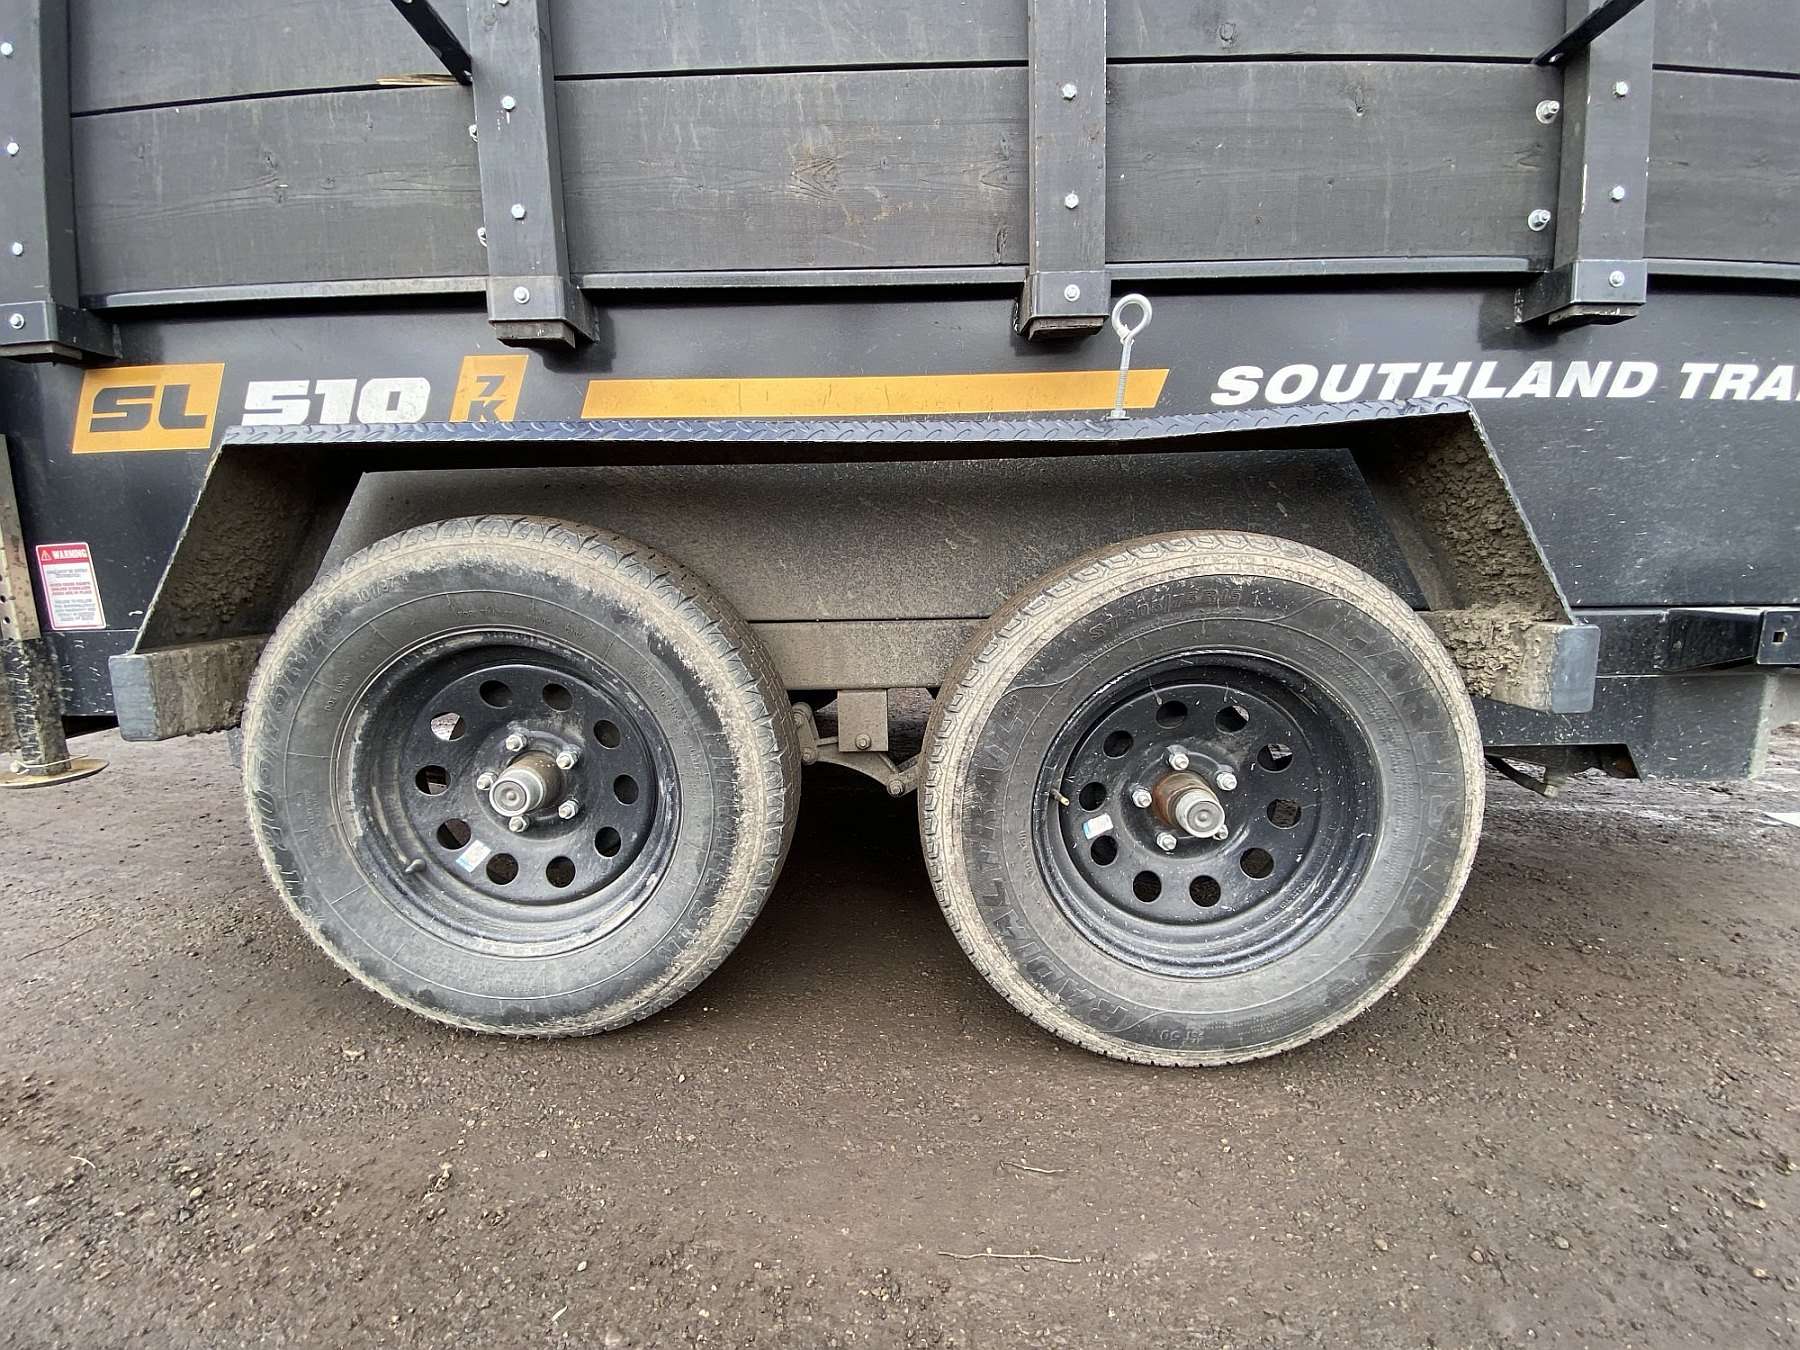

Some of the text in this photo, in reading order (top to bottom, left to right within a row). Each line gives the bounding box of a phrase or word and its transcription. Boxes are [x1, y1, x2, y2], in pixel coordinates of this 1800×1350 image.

[89, 383, 209, 433] SL
[240, 377, 431, 426] 510
[1210, 361, 1800, 406] SOUTHLAND TRA
